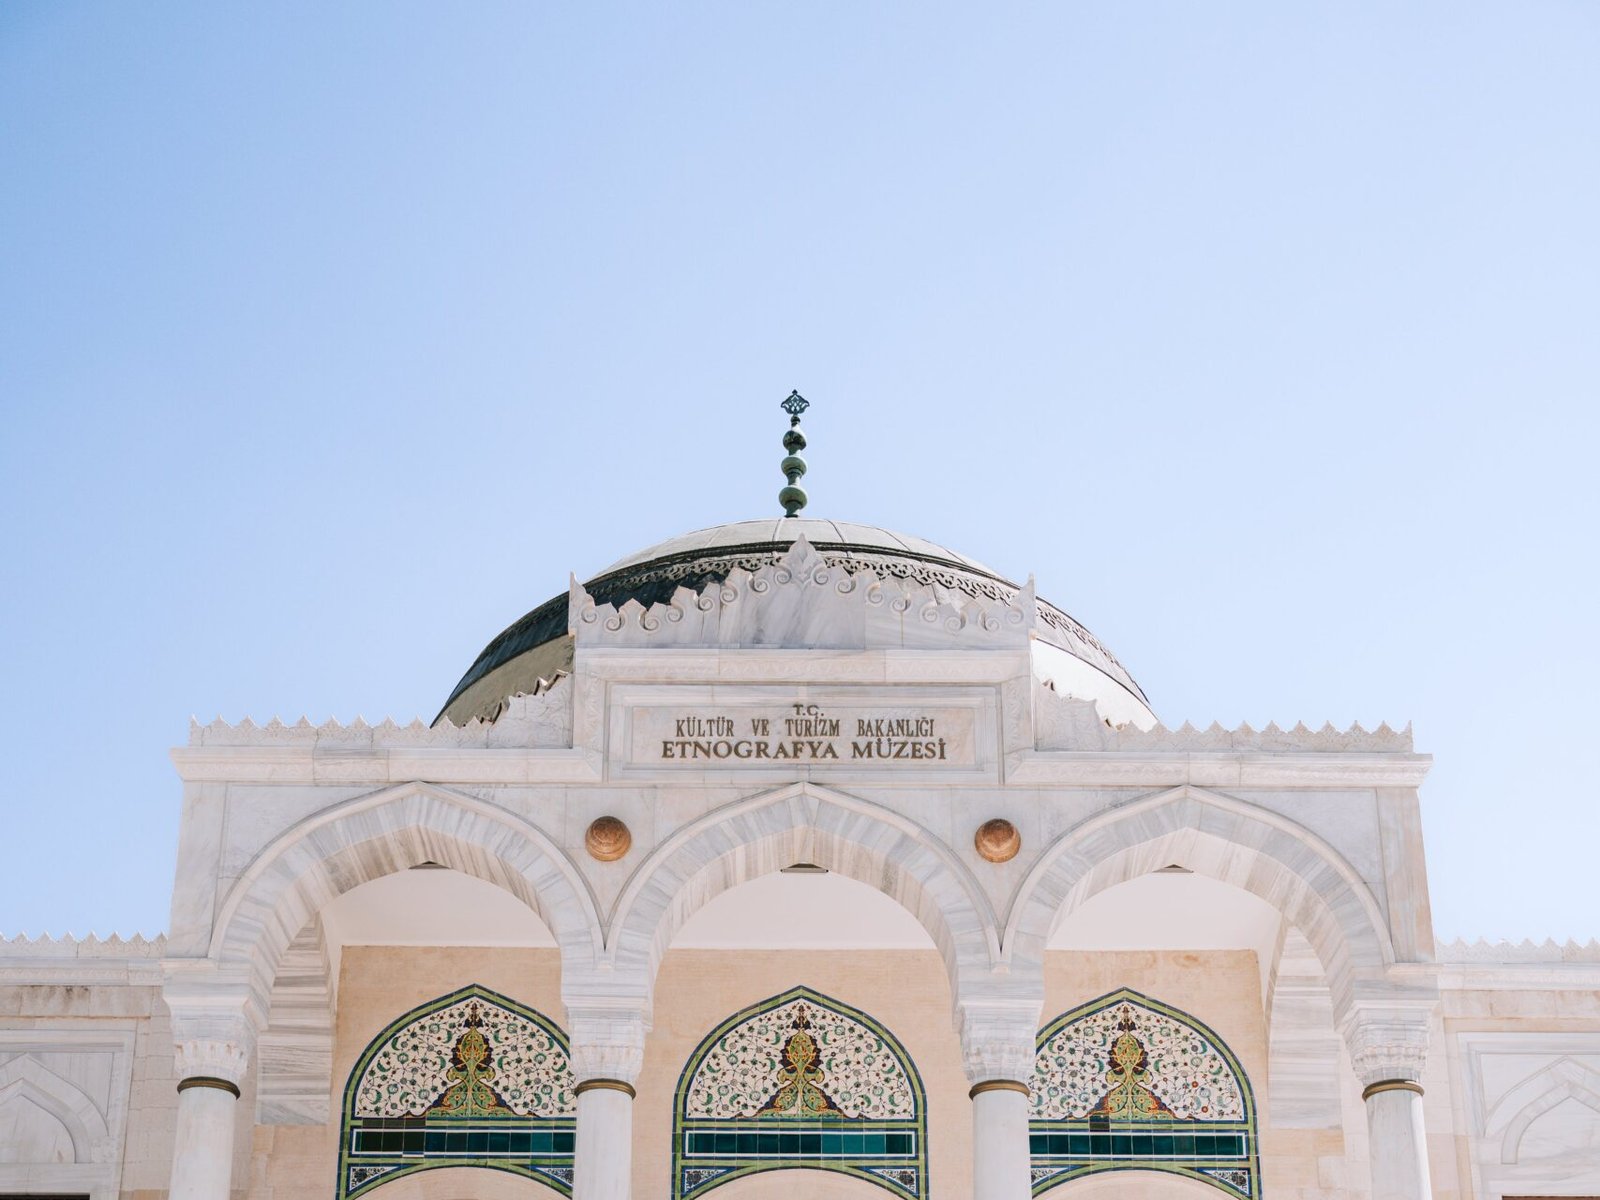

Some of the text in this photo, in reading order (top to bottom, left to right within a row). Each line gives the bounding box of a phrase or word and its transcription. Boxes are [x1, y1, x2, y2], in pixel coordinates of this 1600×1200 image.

[675, 716, 935, 738] KÜLTÜR VE TURİZM BAKANLIĞI
[661, 737, 947, 760] ETNOGRAFYA MÜZESİ
